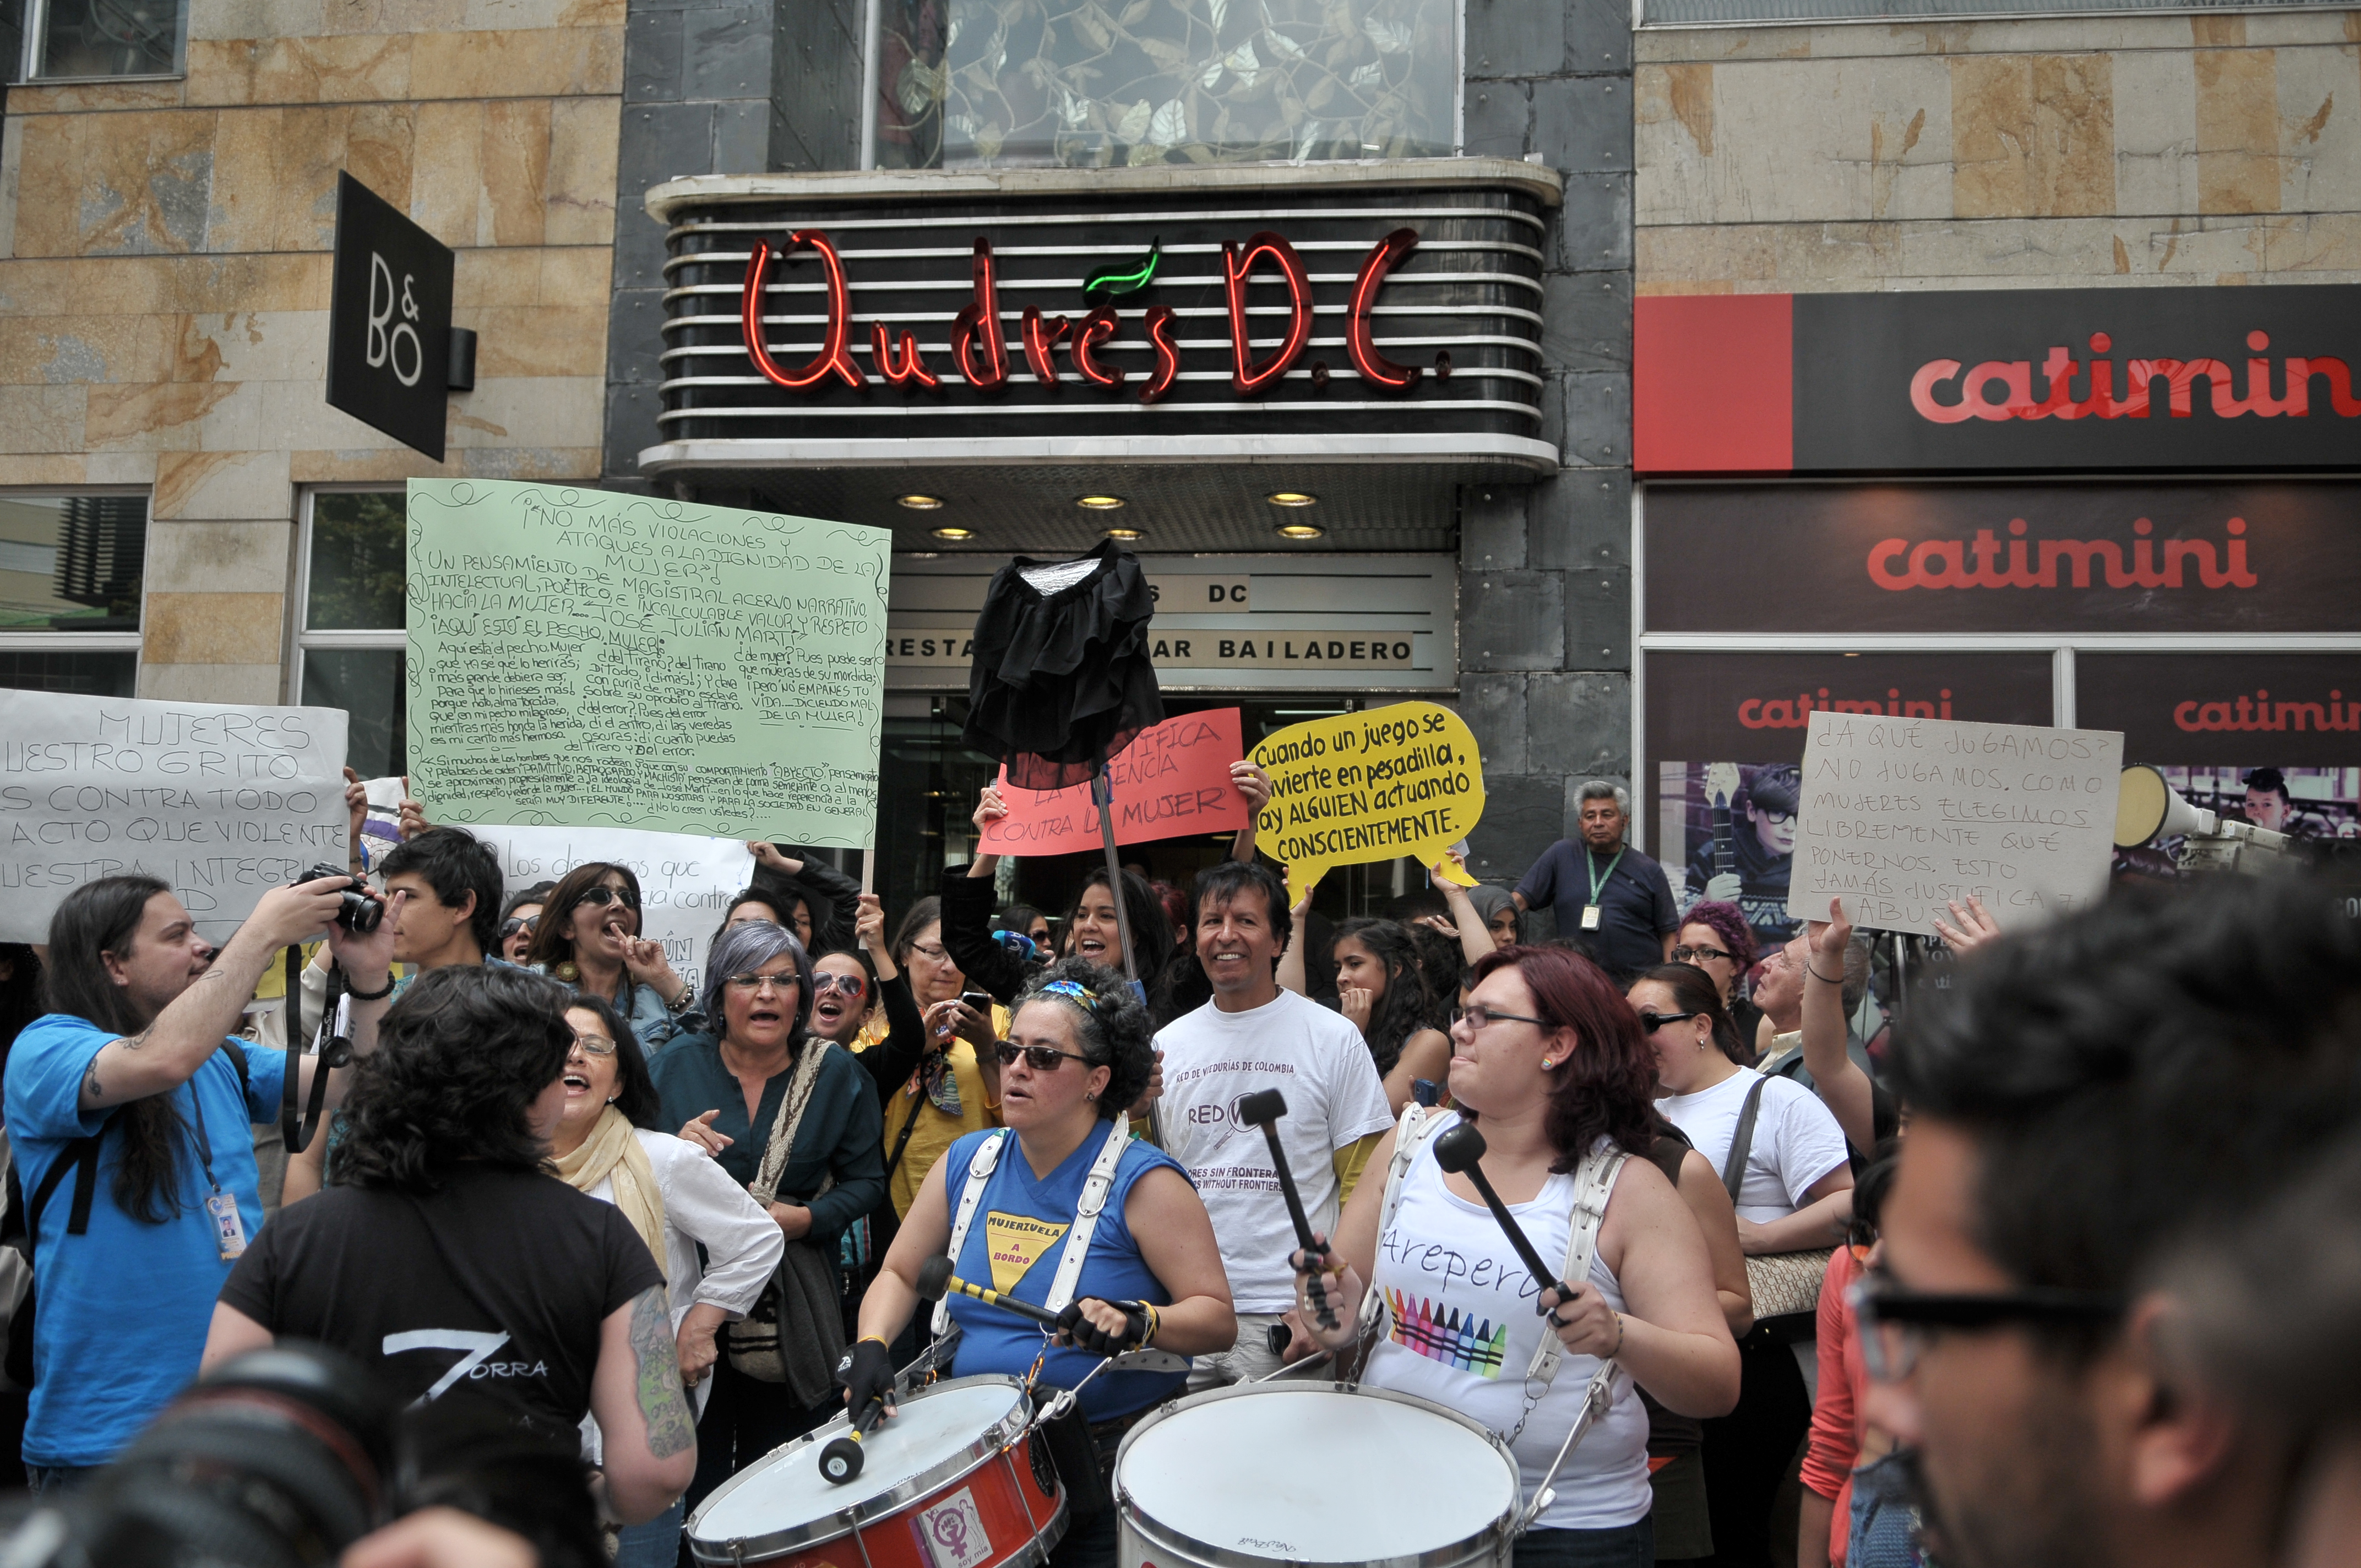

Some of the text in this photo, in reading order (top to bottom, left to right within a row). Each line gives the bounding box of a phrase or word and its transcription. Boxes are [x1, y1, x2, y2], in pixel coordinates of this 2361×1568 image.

[1222, 227, 1451, 394] D.C.
[588, 513, 636, 536] MÁS
[649, 522, 766, 548] VIOLACIONES
[780, 538, 791, 555] Y
[556, 530, 875, 577] ATAQUES A LA DIGNIDAD DE LA
[1867, 517, 2257, 590] catimini
[428, 549, 455, 570] UN
[463, 554, 578, 575] PENSAMIENTO
[579, 567, 613, 585] DE
[623, 578, 728, 604] MAGISTRAL
[732, 592, 791, 610] ACERVO
[1209, 585, 1247, 602] DC
[427, 574, 541, 593] INTELECTUAL,
[638, 594, 743, 622] INCALCULABLE
[748, 613, 793, 628] VALOR
[797, 617, 808, 635] Y
[810, 616, 868, 635] RESPETO
[432, 589, 476, 611] HACIA
[481, 594, 502, 610] LA
[661, 617, 730, 638] JULIÁN
[525, 620, 542, 634] EL
[438, 641, 467, 661] Aquí
[469, 639, 494, 655] está
[494, 640, 504, 654] el
[550, 641, 586, 657] Mujer
[520, 657, 530, 669] lo
[796, 648, 823, 665] Pues
[828, 652, 857, 668] puede
[1219, 640, 1411, 660] BAILADERO
[803, 666, 815, 678] de
[818, 670, 831, 680] su
[853, 686, 869, 696] TU
[99, 710, 310, 750] MUJERES
[759, 710, 784, 720] DE
[785, 711, 801, 720] LA
[1254, 712, 1446, 769] Cuando un juego se
[1867, 721, 1924, 749] QUÉ
[1944, 729, 2110, 760] JUGAMOS?
[6, 741, 299, 779] UESTRO GRITO
[1337, 764, 1362, 787] en
[1366, 743, 1466, 790] pesadilla,
[1814, 758, 2103, 793] NO JUGAMOS. COMO
[48, 785, 200, 812] CONTRA
[207, 788, 318, 814] TODO
[987, 815, 1073, 842] CONTRA
[1122, 786, 1227, 827] MUJER
[1290, 790, 1368, 826] ALGUIEN
[1373, 770, 1470, 810] actuando
[1813, 791, 2093, 826] MUJERES ELEGIMOS
[12, 817, 346, 849] ACTO QUE VIOLENTE
[1277, 807, 1460, 861] CONSCIENTEMENTE.
[1806, 819, 2061, 852] LIBREMENTE QUÉ
[508, 839, 541, 878] Los
[661, 861, 700, 889] que
[1811, 846, 2017, 880] PONERNOS. ESTO
[1814, 869, 1894, 896] JAMÁS
[1176, 1071, 1189, 1084] RED
[1191, 1069, 1201, 1079] DE
[1242, 1061, 1252, 1071] DE
[1255, 1061, 1294, 1074] COLOMBIA
[1188, 1104, 1225, 1126] RED
[1203, 1179, 1237, 1189] WITHOUT
[1209, 1168, 1226, 1178] SIN
[987, 1216, 1060, 1238] MUJERZUELA
[993, 1252, 1031, 1265] BORDO
[1011, 1243, 1020, 1252] A
[958, 1556, 972, 1568] soy
